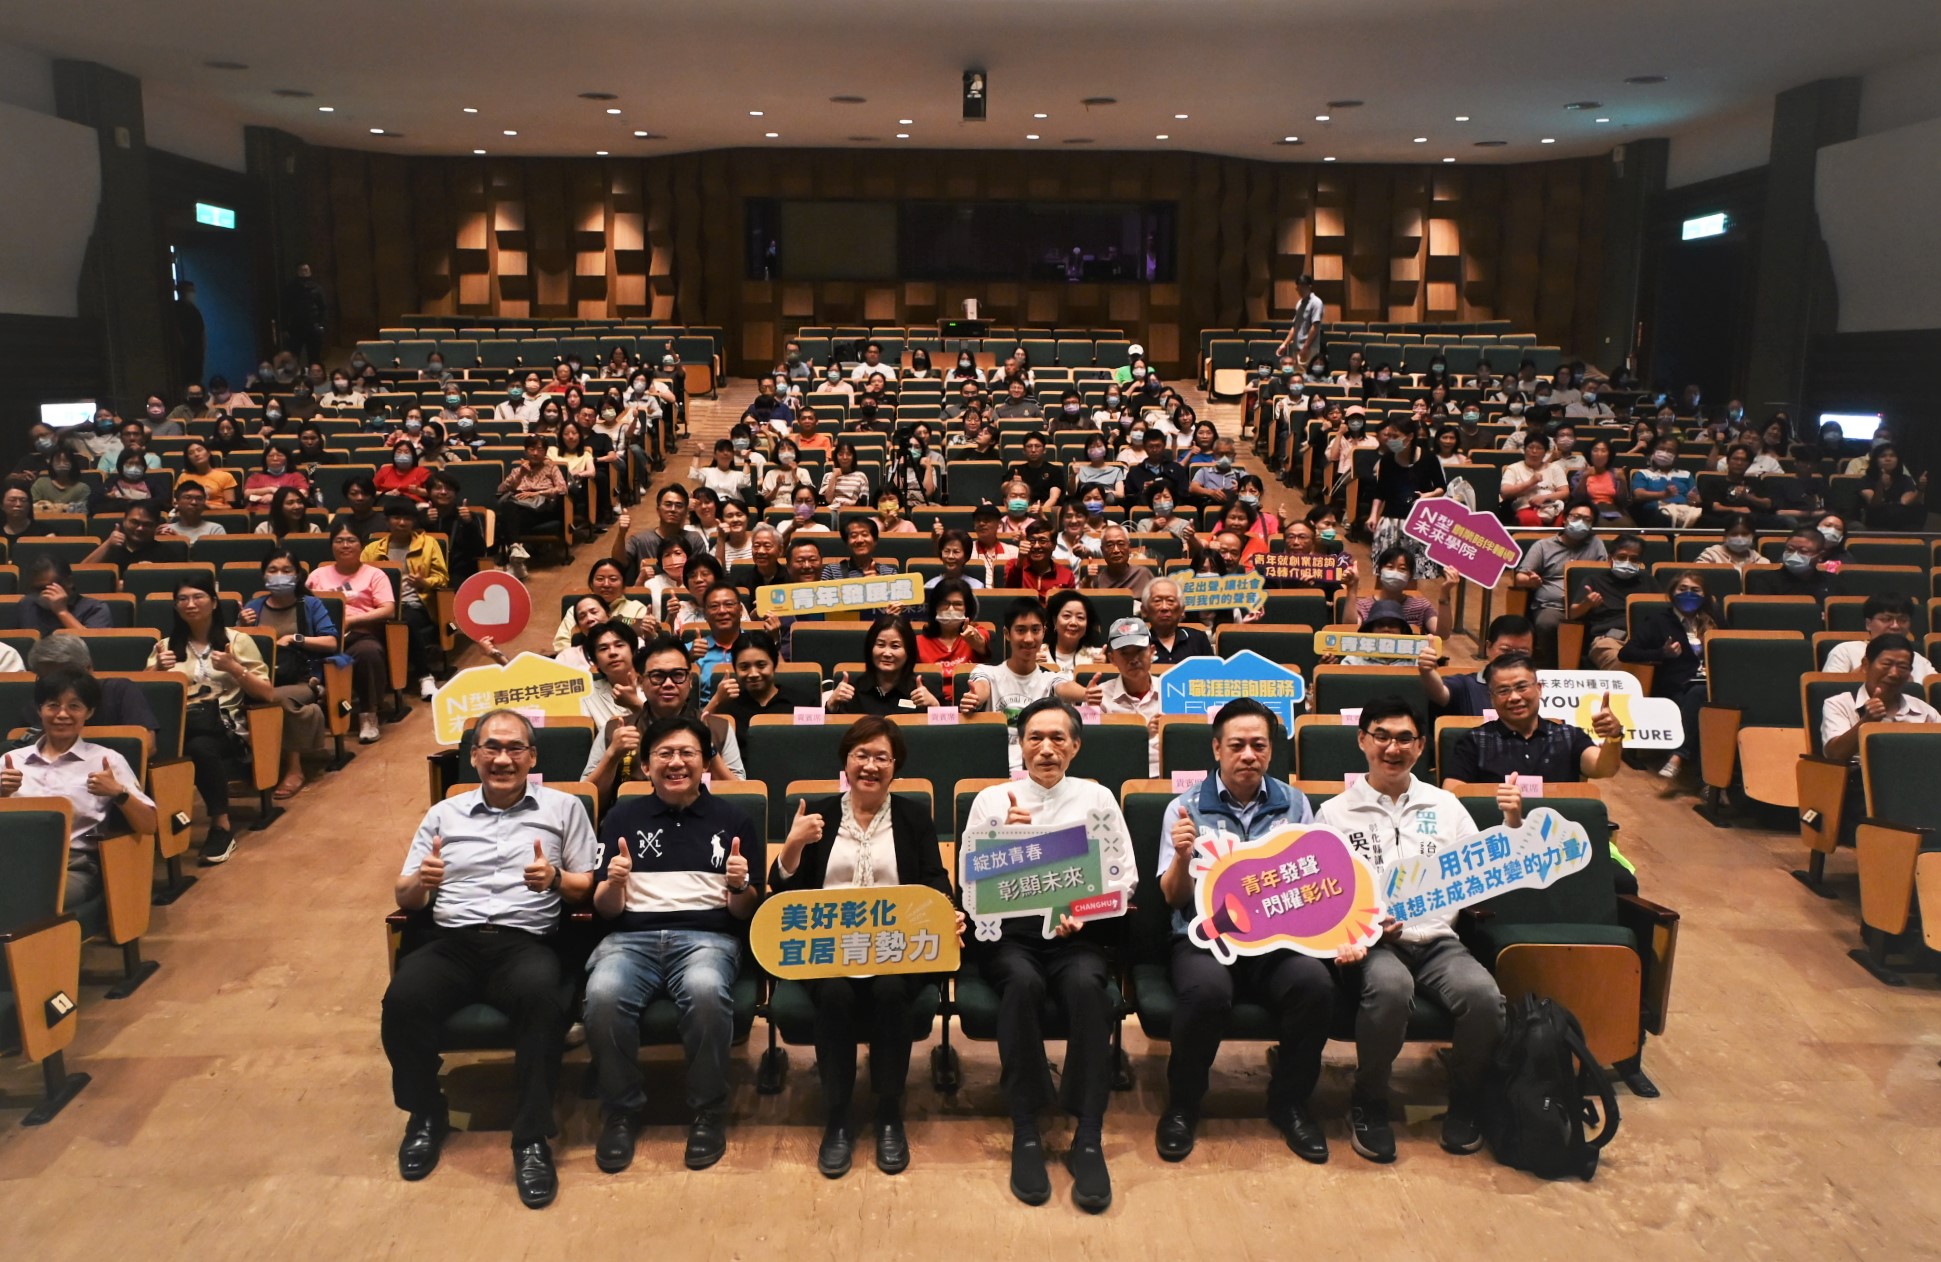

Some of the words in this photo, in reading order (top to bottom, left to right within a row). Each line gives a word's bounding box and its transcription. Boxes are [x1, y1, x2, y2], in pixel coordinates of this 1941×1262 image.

[1413, 519, 1478, 560] 未來學院
[494, 678, 585, 705] 青年共享空間
[1188, 679, 1295, 697] 職涯諮詢服務
[1624, 729, 1673, 741] TURE
[973, 843, 1043, 872] 綻放青春
[1241, 854, 1321, 896] 青年發聲
[1438, 832, 1512, 880] 用行動
[1261, 877, 1343, 918] 閃耀彰化
[1387, 837, 1583, 923] 讓想法成為改變的力量
[781, 899, 897, 931] 美好彰化
[778, 929, 940, 967] 宜居青勢力
